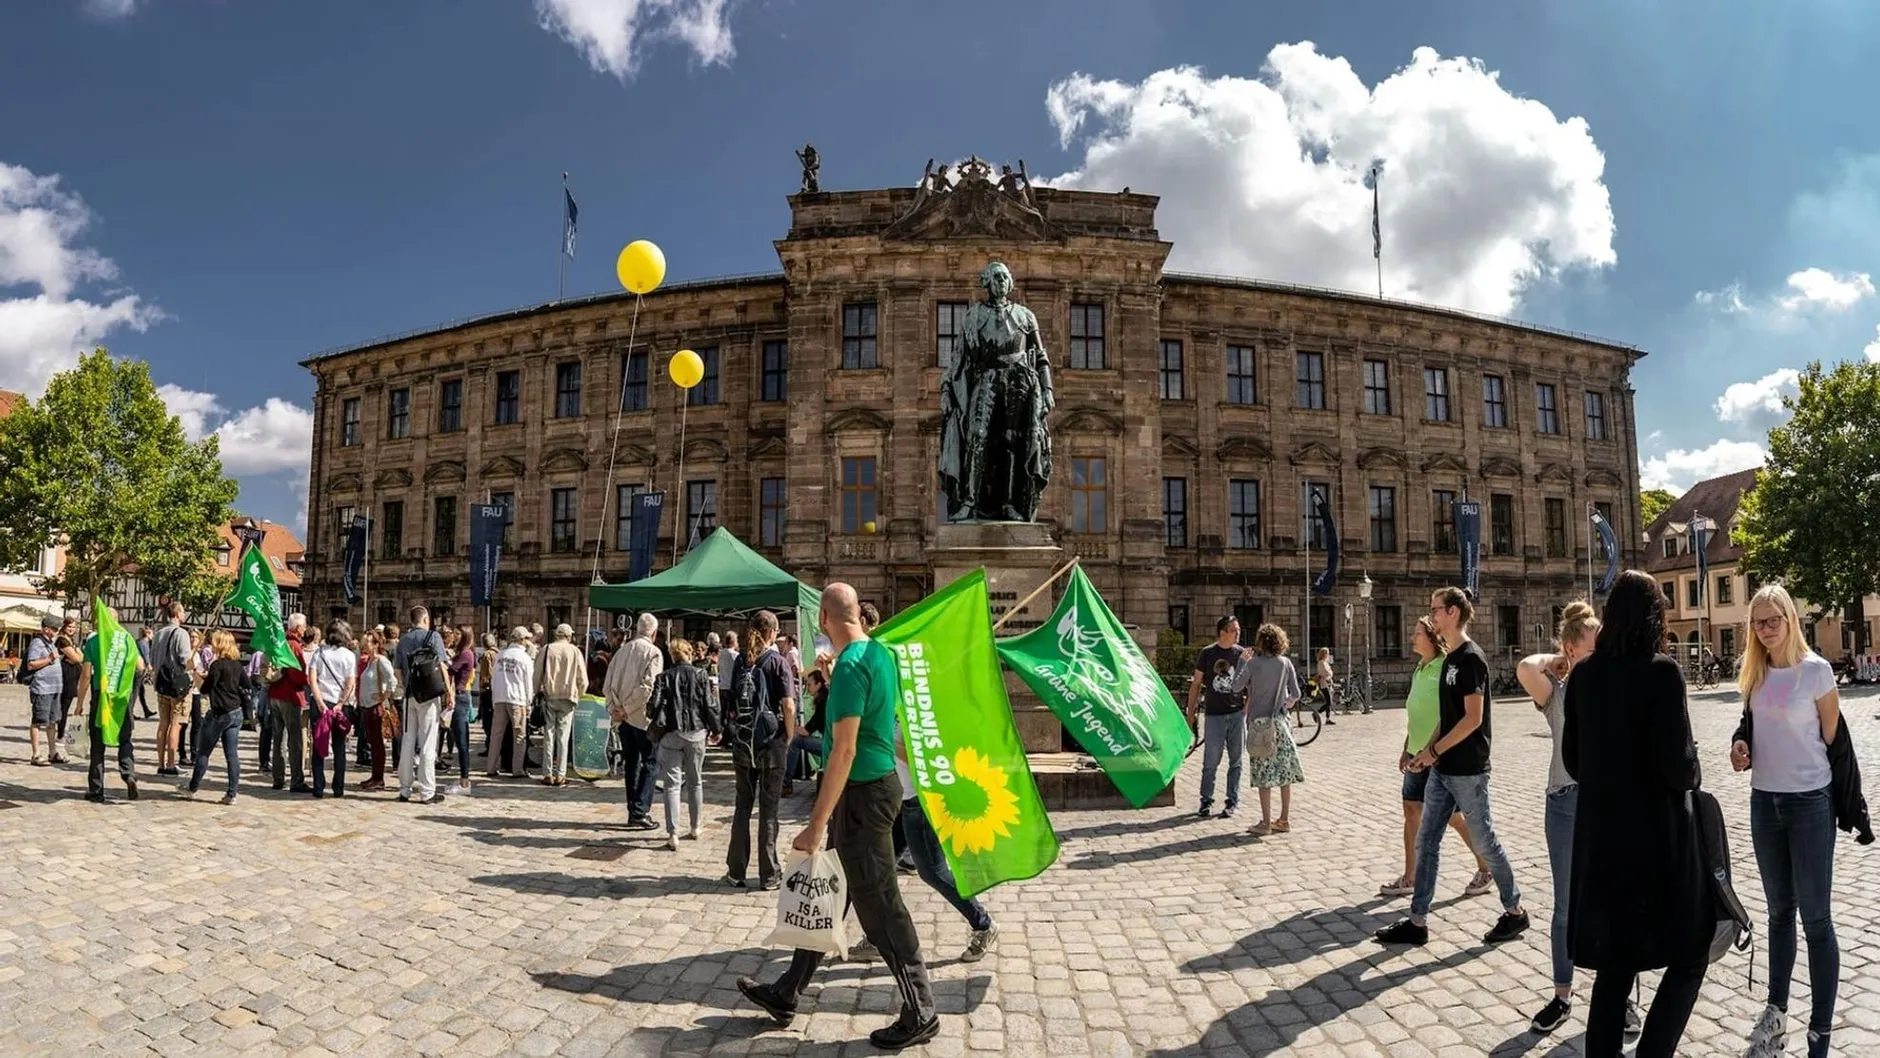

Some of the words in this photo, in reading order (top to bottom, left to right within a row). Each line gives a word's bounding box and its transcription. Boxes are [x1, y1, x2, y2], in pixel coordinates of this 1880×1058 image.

[643, 496, 662, 507] FAU
[1461, 505, 1478, 515] FAU
[482, 507, 502, 517] FAU
[895, 644, 912, 680] DIE
[904, 689, 932, 788] GRÜNEN
[908, 642, 943, 750] BÜNDNIS
[929, 754, 956, 785] 90
[1070, 700, 1131, 755] Jugend
[798, 901, 811, 916] IS
[812, 905, 821, 917] A
[784, 911, 833, 930] KILLER
